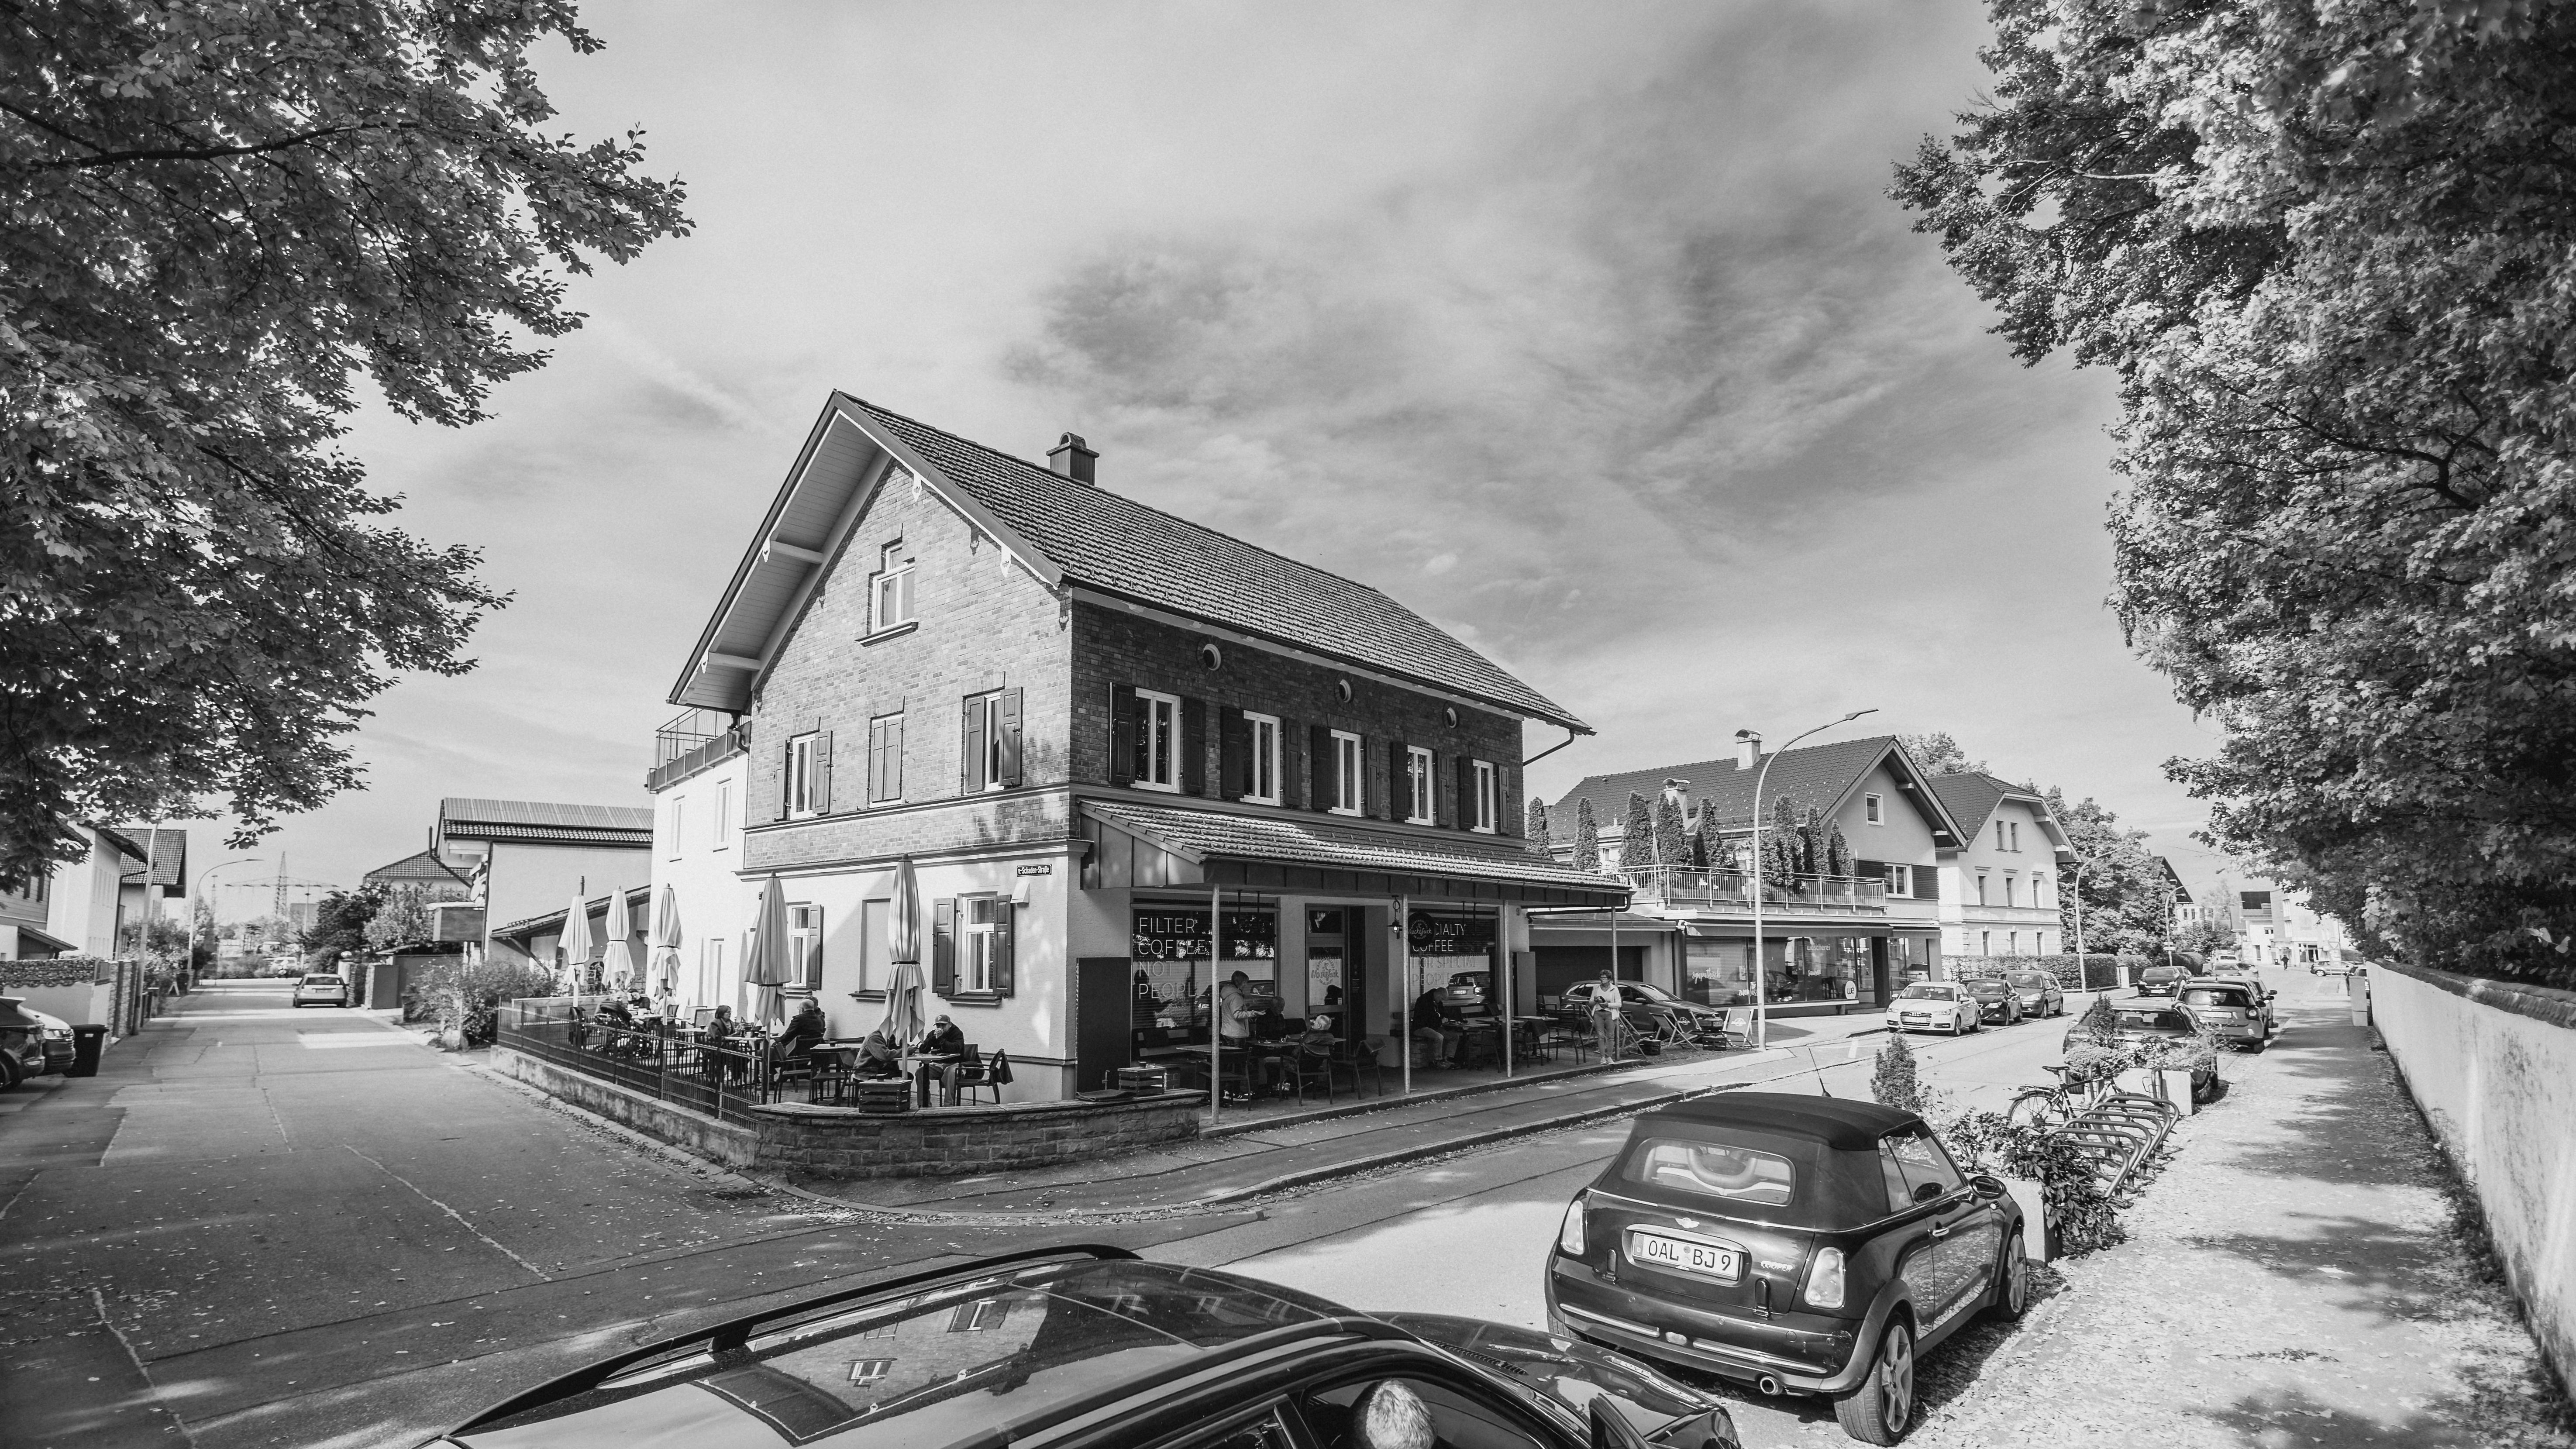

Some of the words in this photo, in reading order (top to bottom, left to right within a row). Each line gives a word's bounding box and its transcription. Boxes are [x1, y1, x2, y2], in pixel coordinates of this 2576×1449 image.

[1516, 908, 1520, 916] 9
[1140, 918, 1195, 933] FILTER
[1435, 923, 1466, 935] IALTY
[1138, 939, 1206, 955] COFFEE
[1139, 961, 1174, 977] NOT
[1648, 1240, 1679, 1261] OAL
[1692, 1249, 1715, 1268] BJ
[1722, 1255, 1731, 1271] 9
